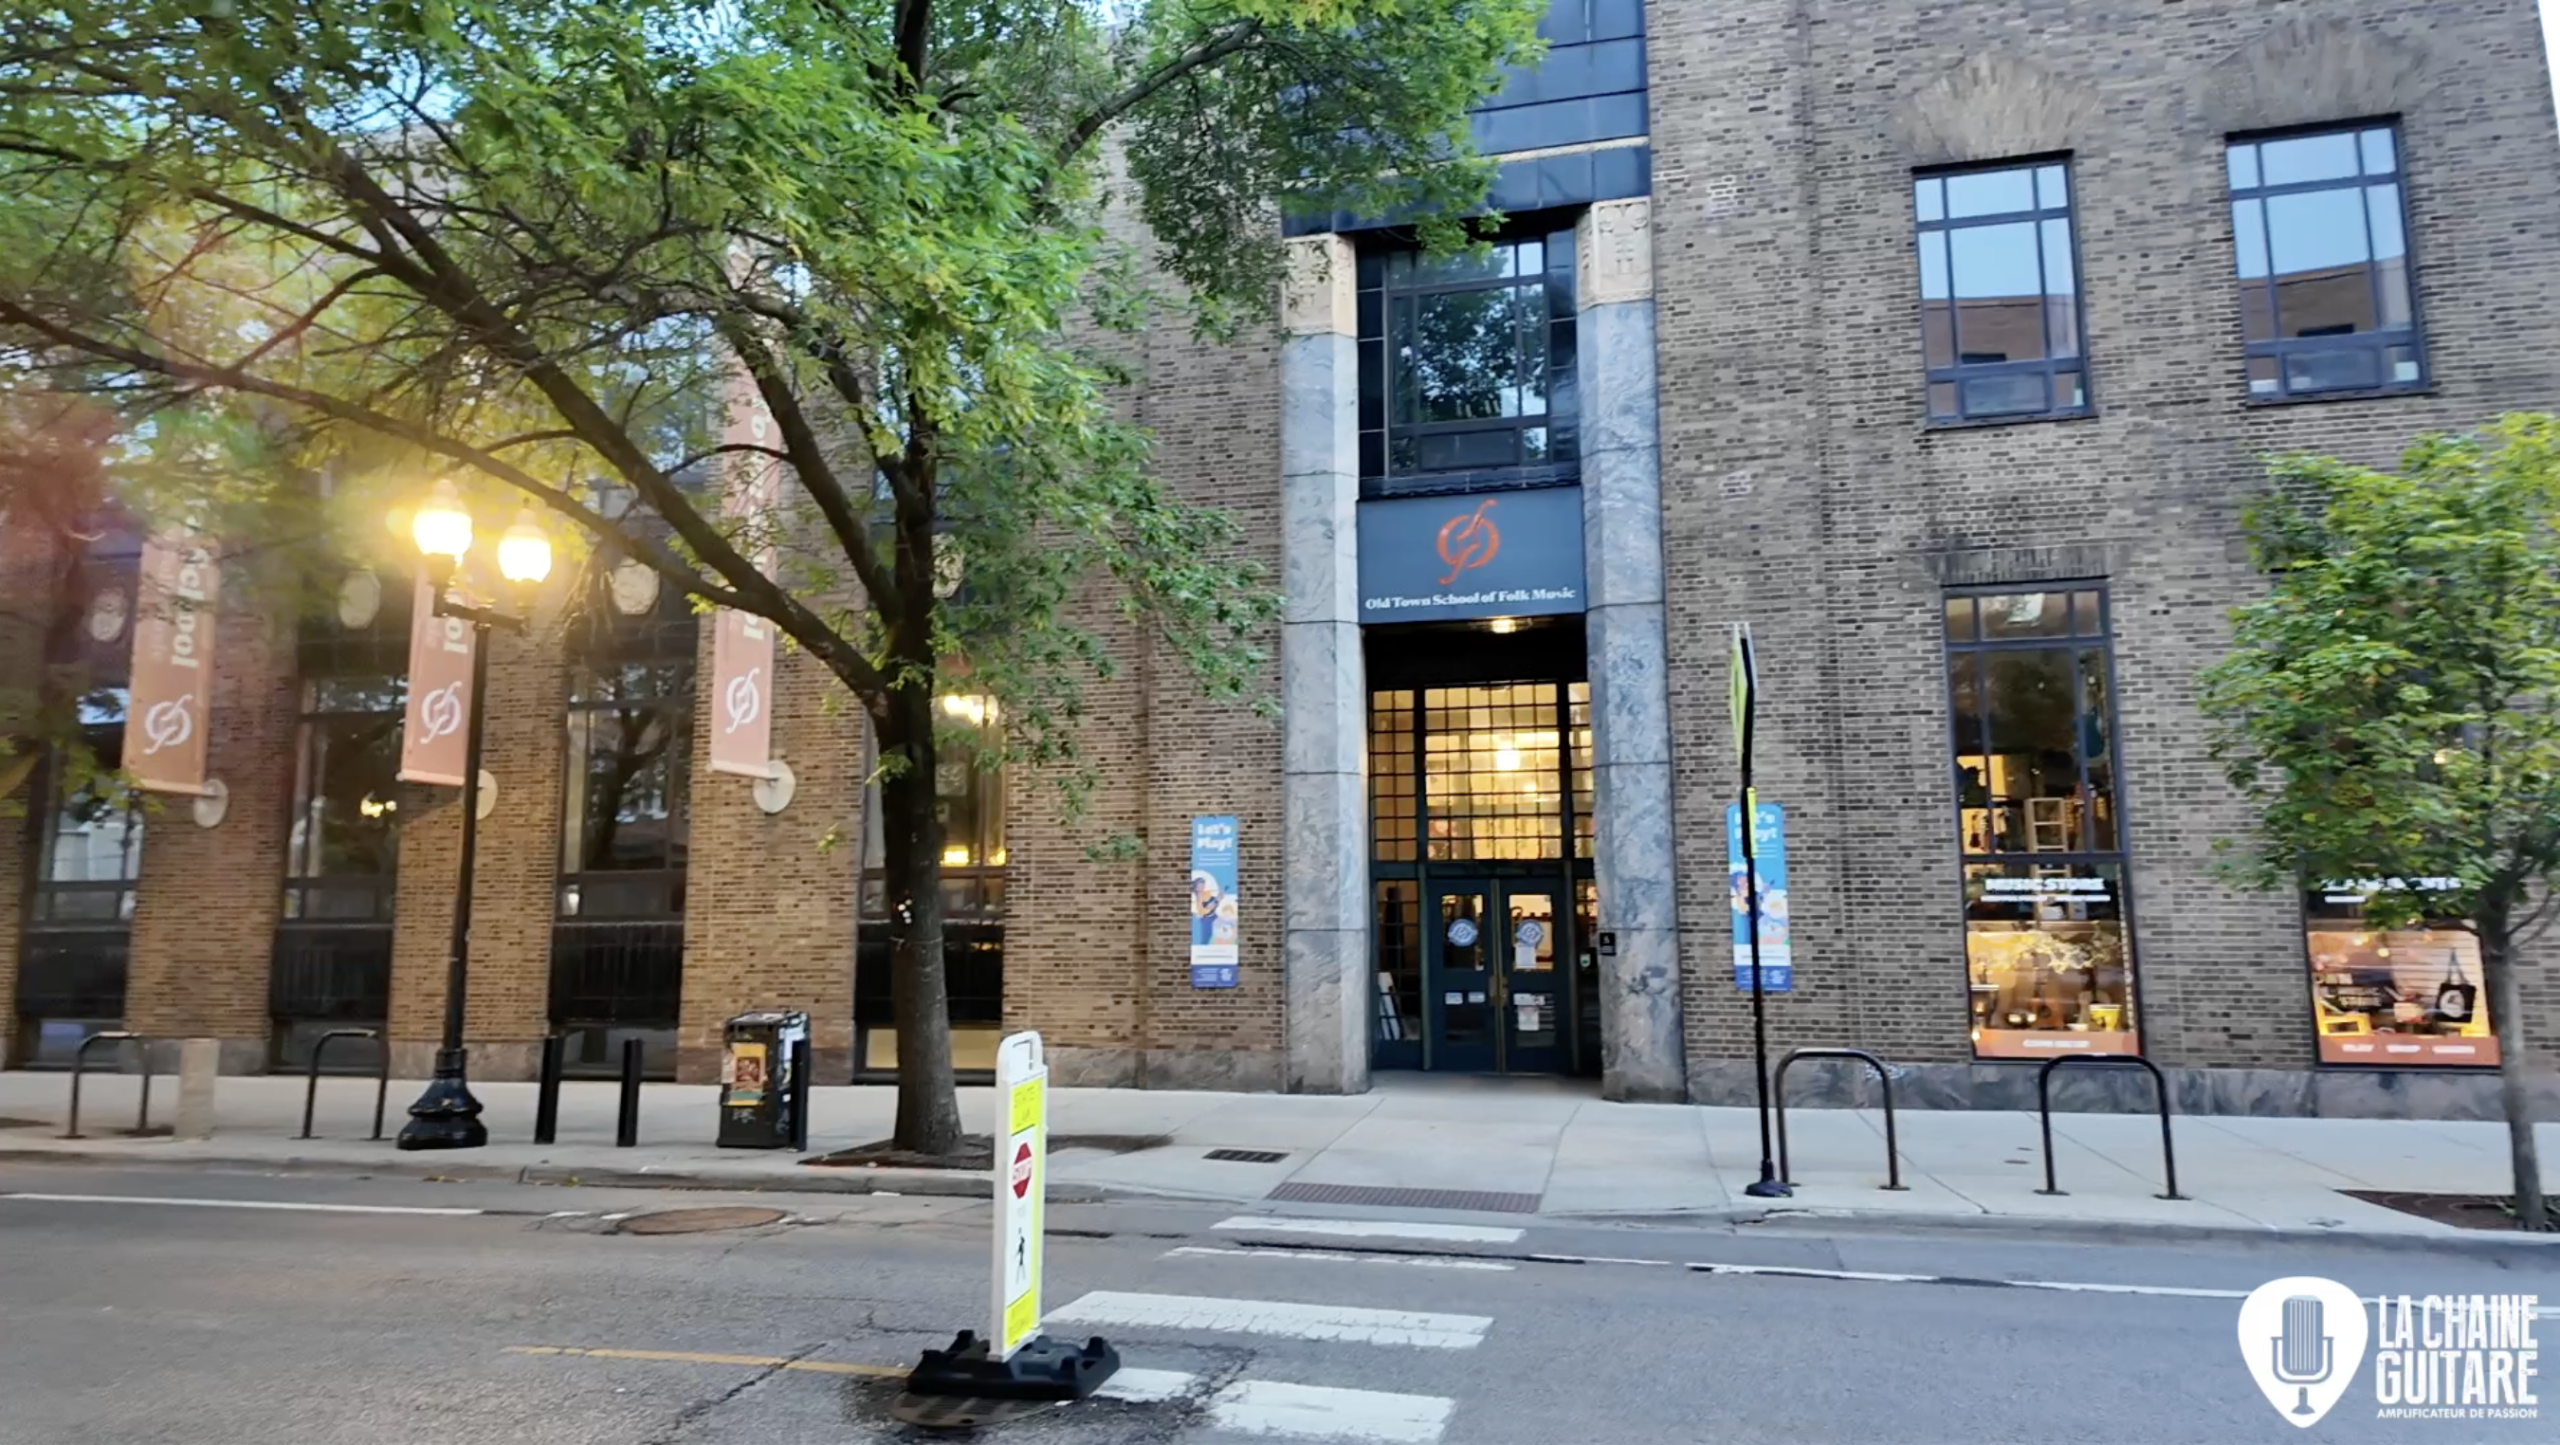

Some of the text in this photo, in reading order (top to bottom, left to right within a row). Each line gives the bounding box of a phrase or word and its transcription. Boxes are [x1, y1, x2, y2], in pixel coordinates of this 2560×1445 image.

[1365, 587, 1576, 609] Old Town School of Folk Music
